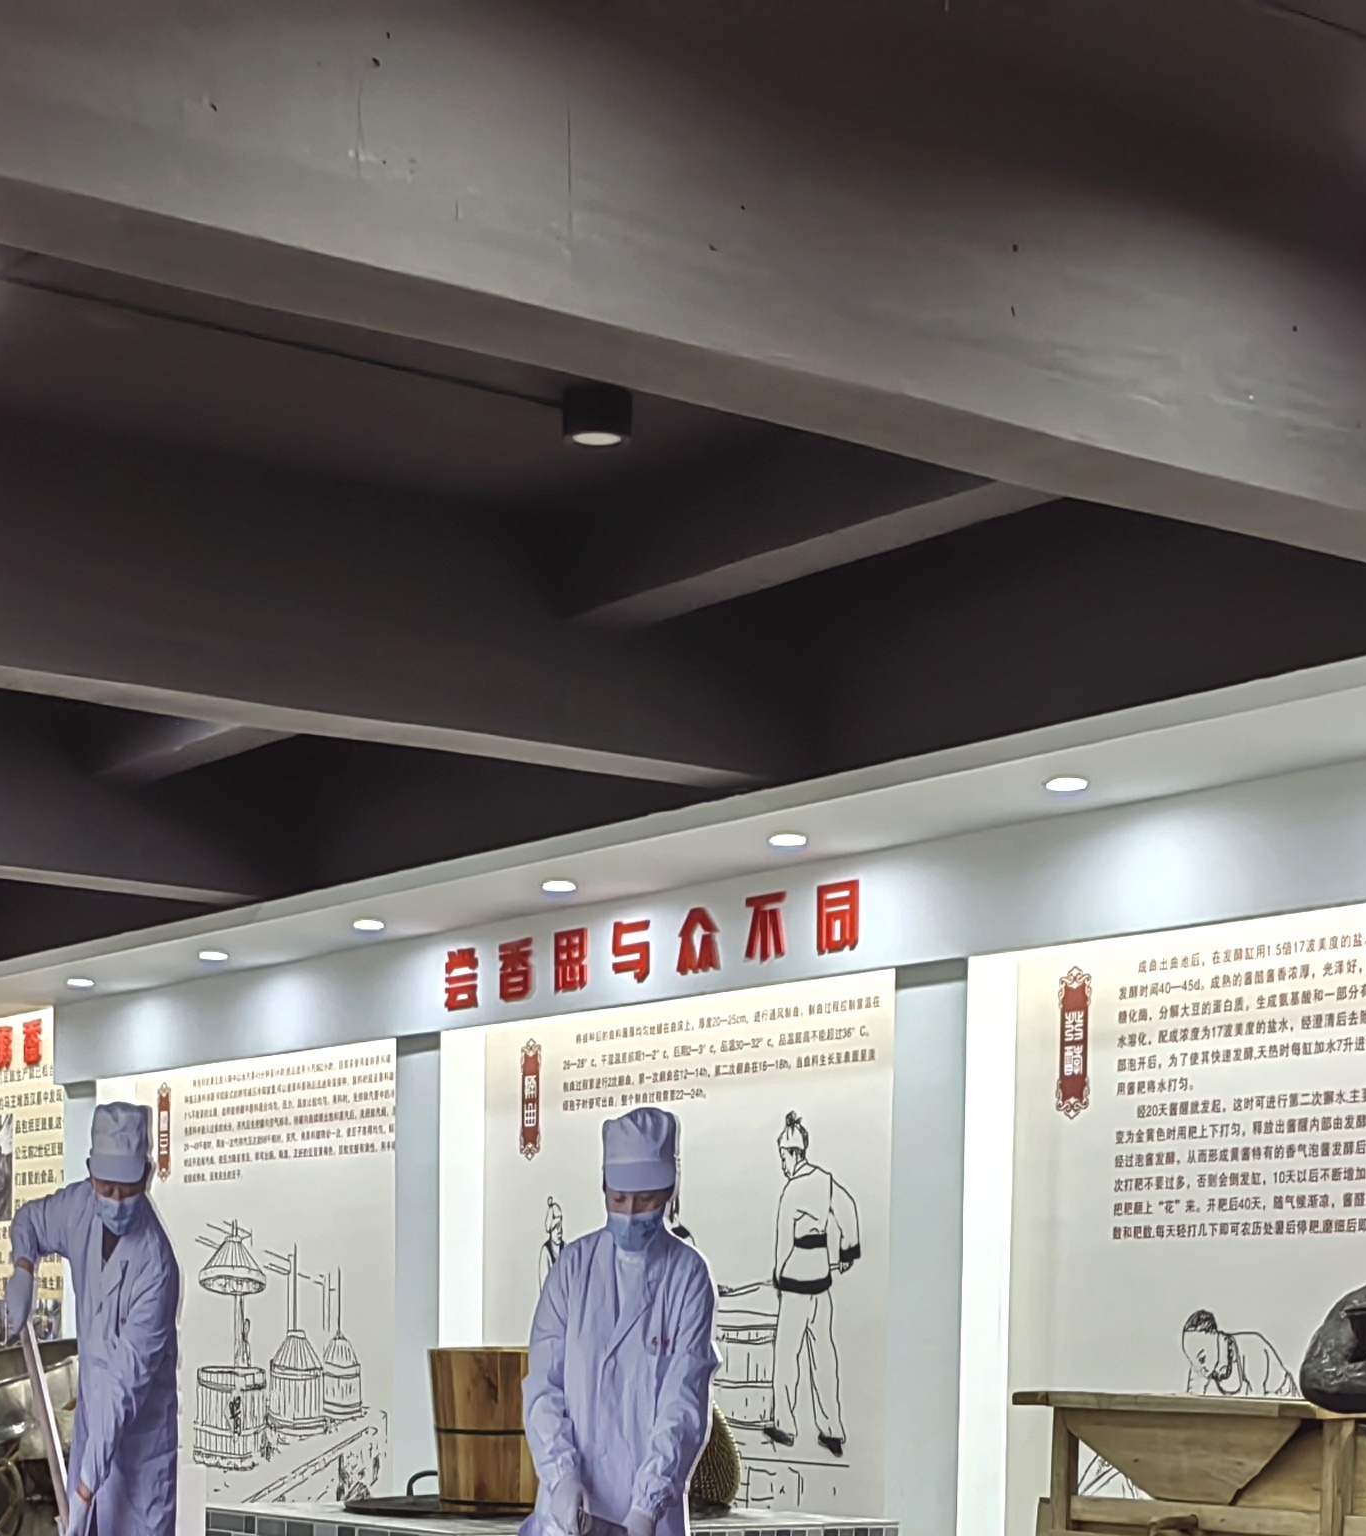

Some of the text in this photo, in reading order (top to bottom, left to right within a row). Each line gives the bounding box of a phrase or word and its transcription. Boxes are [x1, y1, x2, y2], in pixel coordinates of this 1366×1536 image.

[443, 879, 860, 1012] 尝香思与众不同
